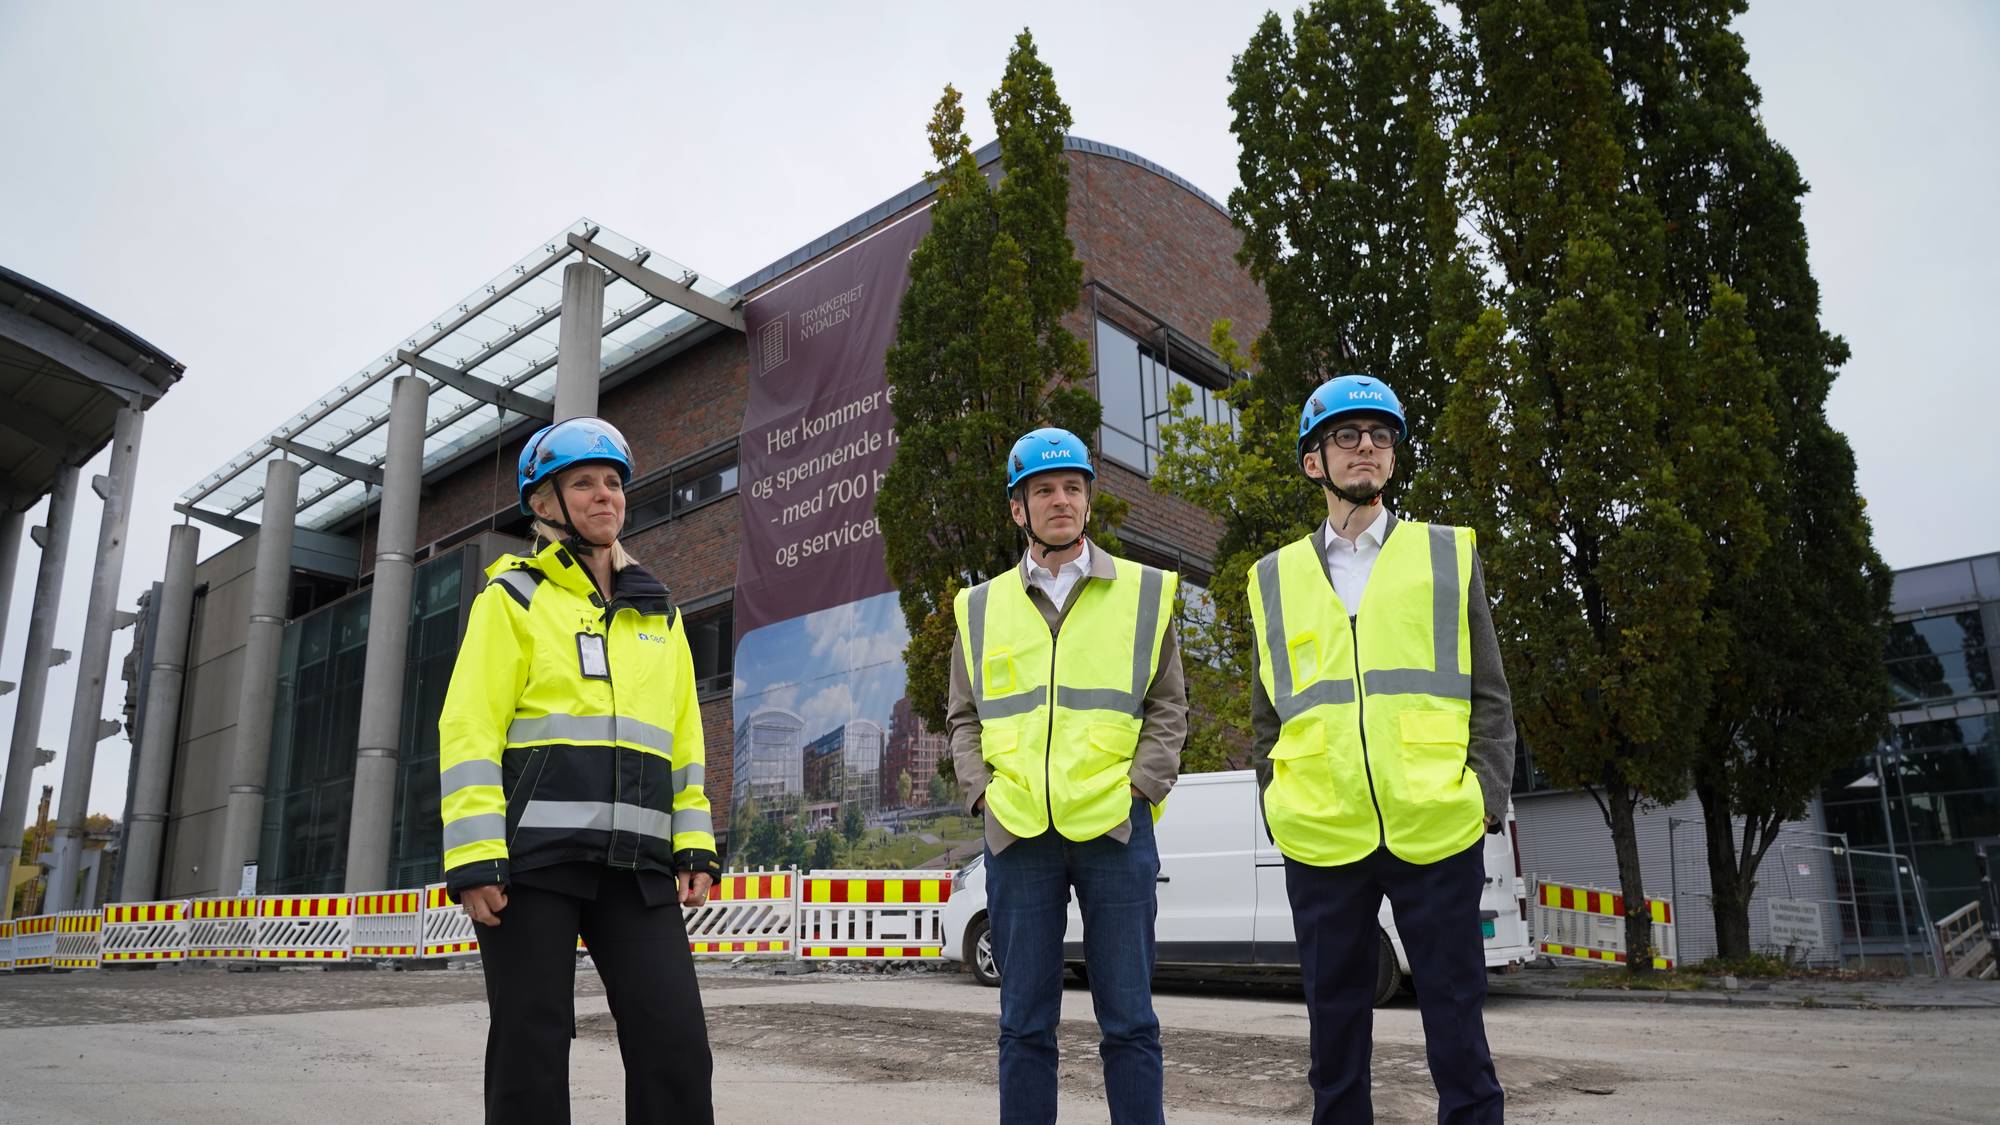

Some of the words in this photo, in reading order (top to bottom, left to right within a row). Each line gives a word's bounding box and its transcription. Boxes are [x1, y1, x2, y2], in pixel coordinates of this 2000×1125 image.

[800, 284, 864, 325] TRYKKERIET
[800, 306, 850, 341] NYDALEN
[1349, 391, 1383, 400] KASK
[767, 426, 798, 455] Her
[802, 390, 882, 441] kommer
[886, 385, 897, 404] e
[752, 475, 774, 499] og
[777, 430, 882, 491] spennende
[1041, 450, 1071, 460] KASK
[782, 488, 823, 526] med
[827, 474, 867, 508] 700
[775, 543, 799, 567] og
[802, 515, 882, 557] servicet
